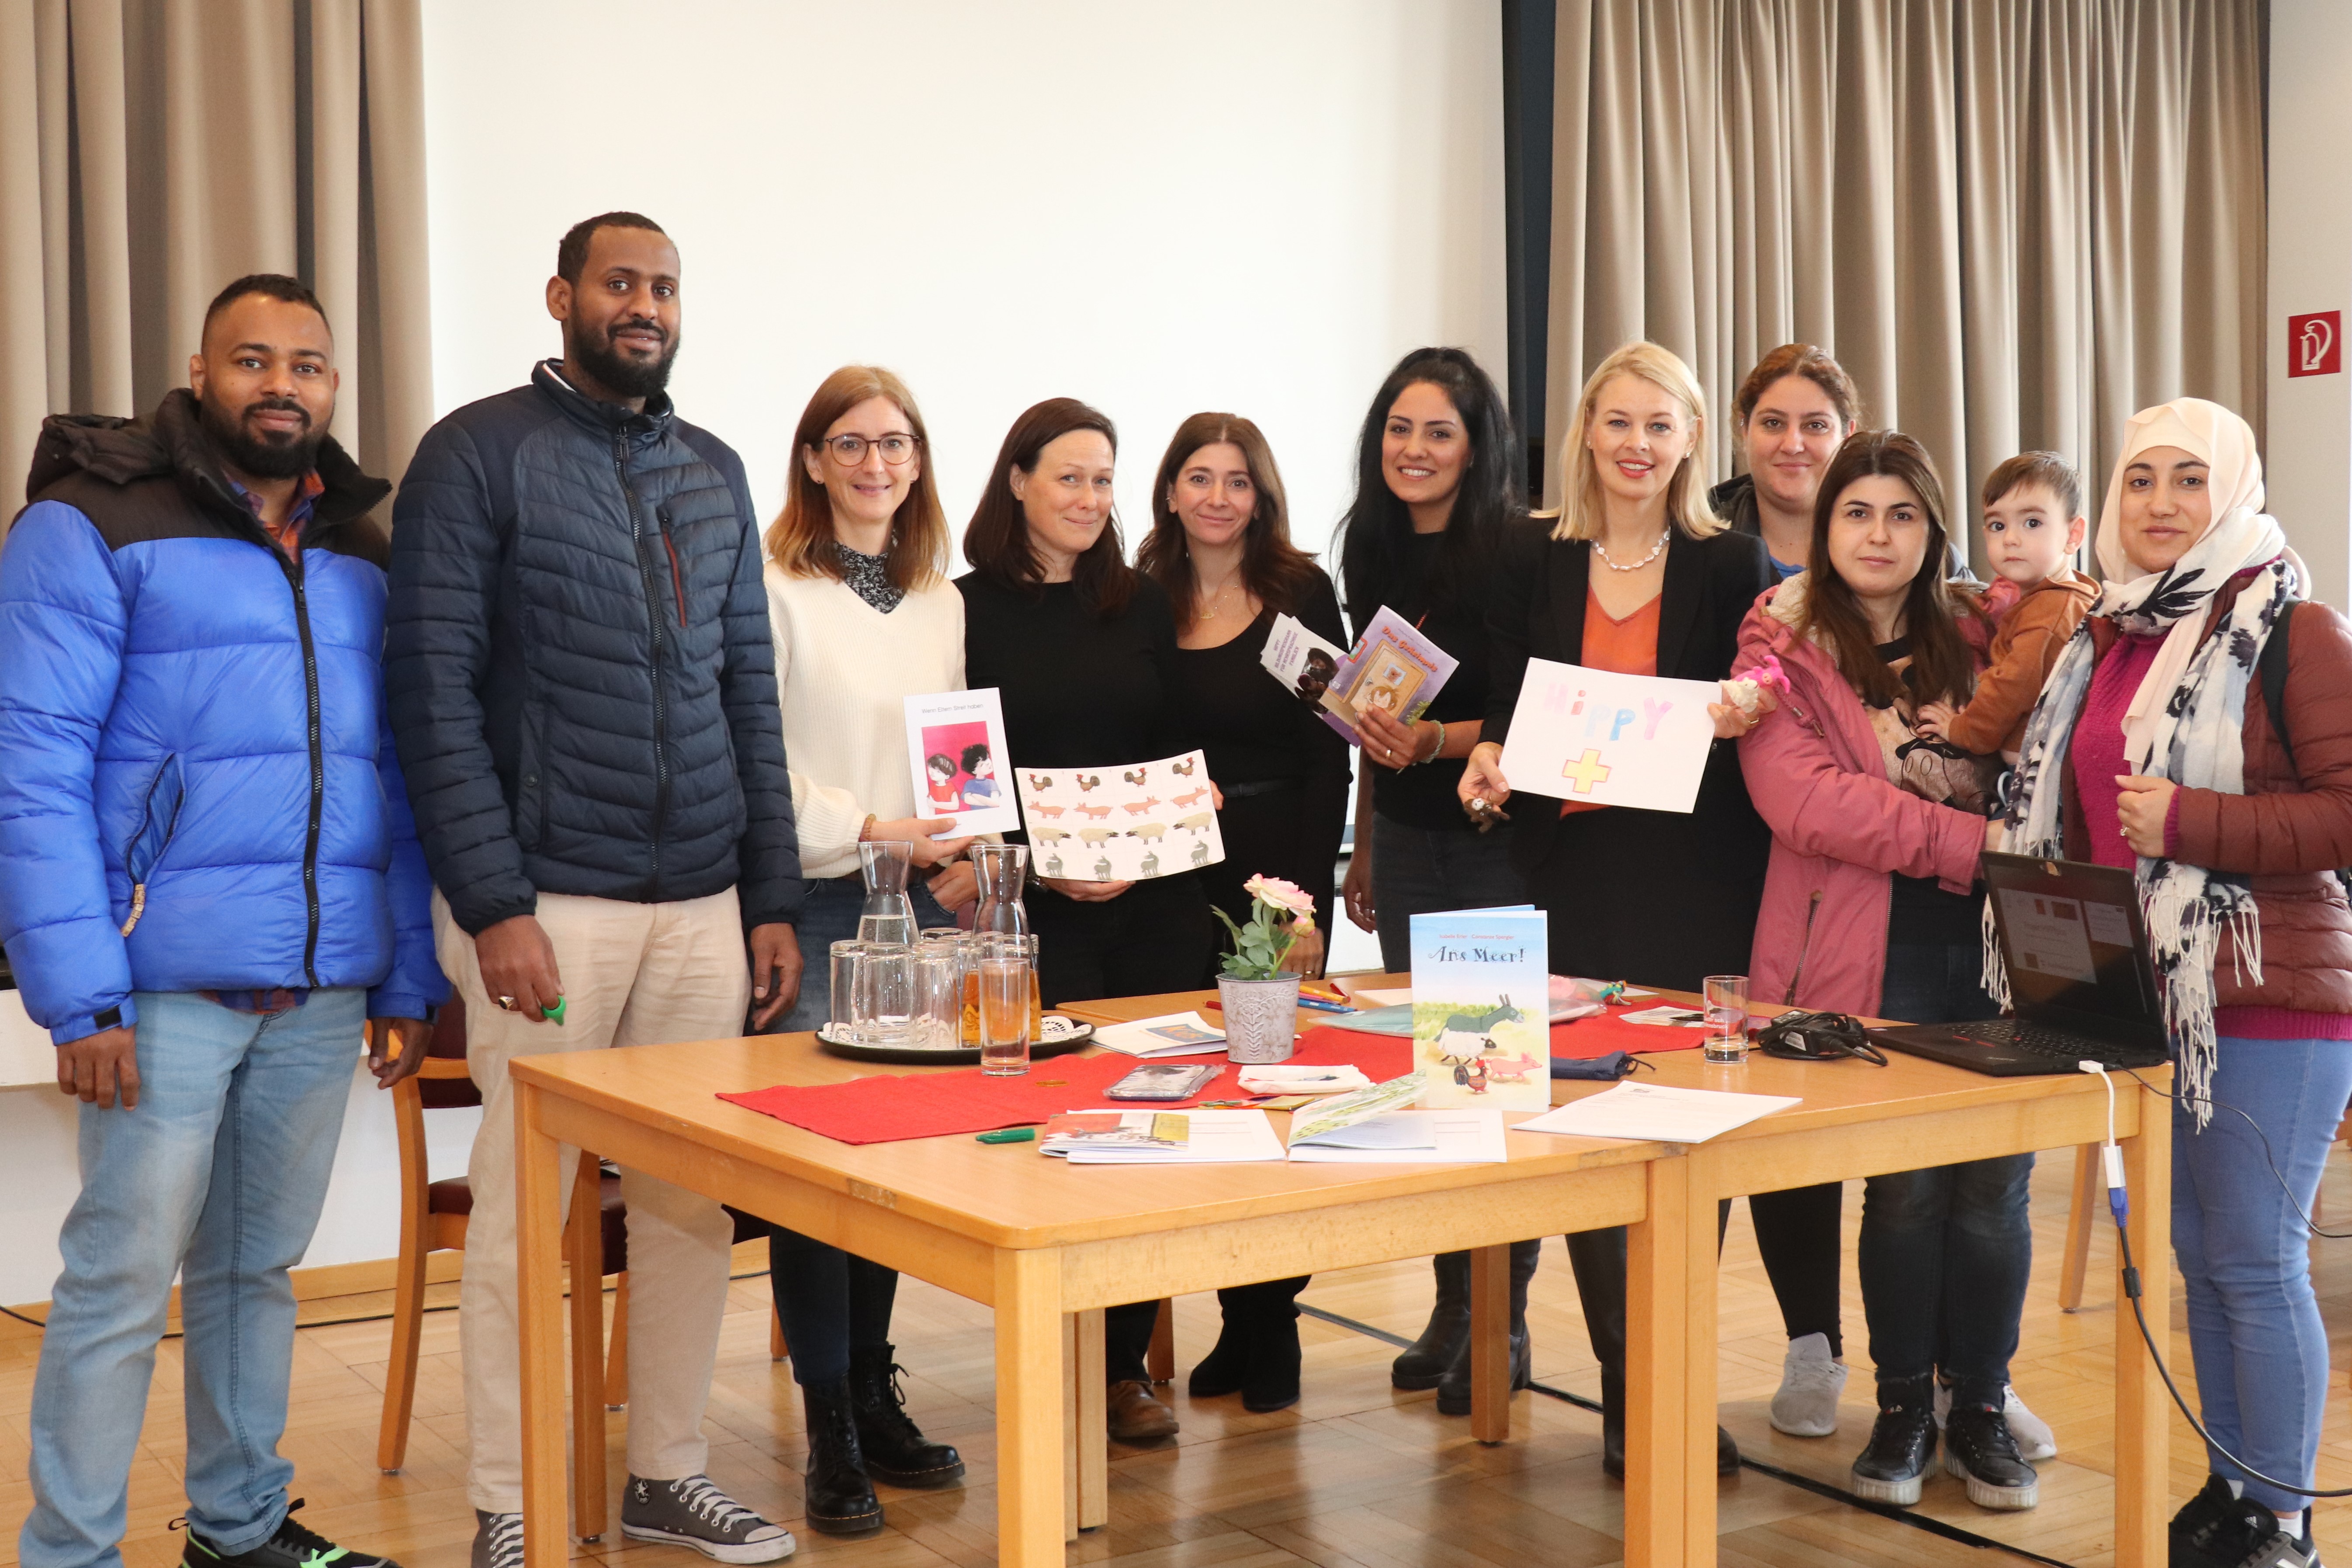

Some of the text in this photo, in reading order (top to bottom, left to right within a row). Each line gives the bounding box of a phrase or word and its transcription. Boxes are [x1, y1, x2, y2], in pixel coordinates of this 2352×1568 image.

[1382, 626, 1398, 643] Das
[1289, 646, 1299, 666] FAMILIEN
[1428, 946, 1526, 962] Ans Meer!
